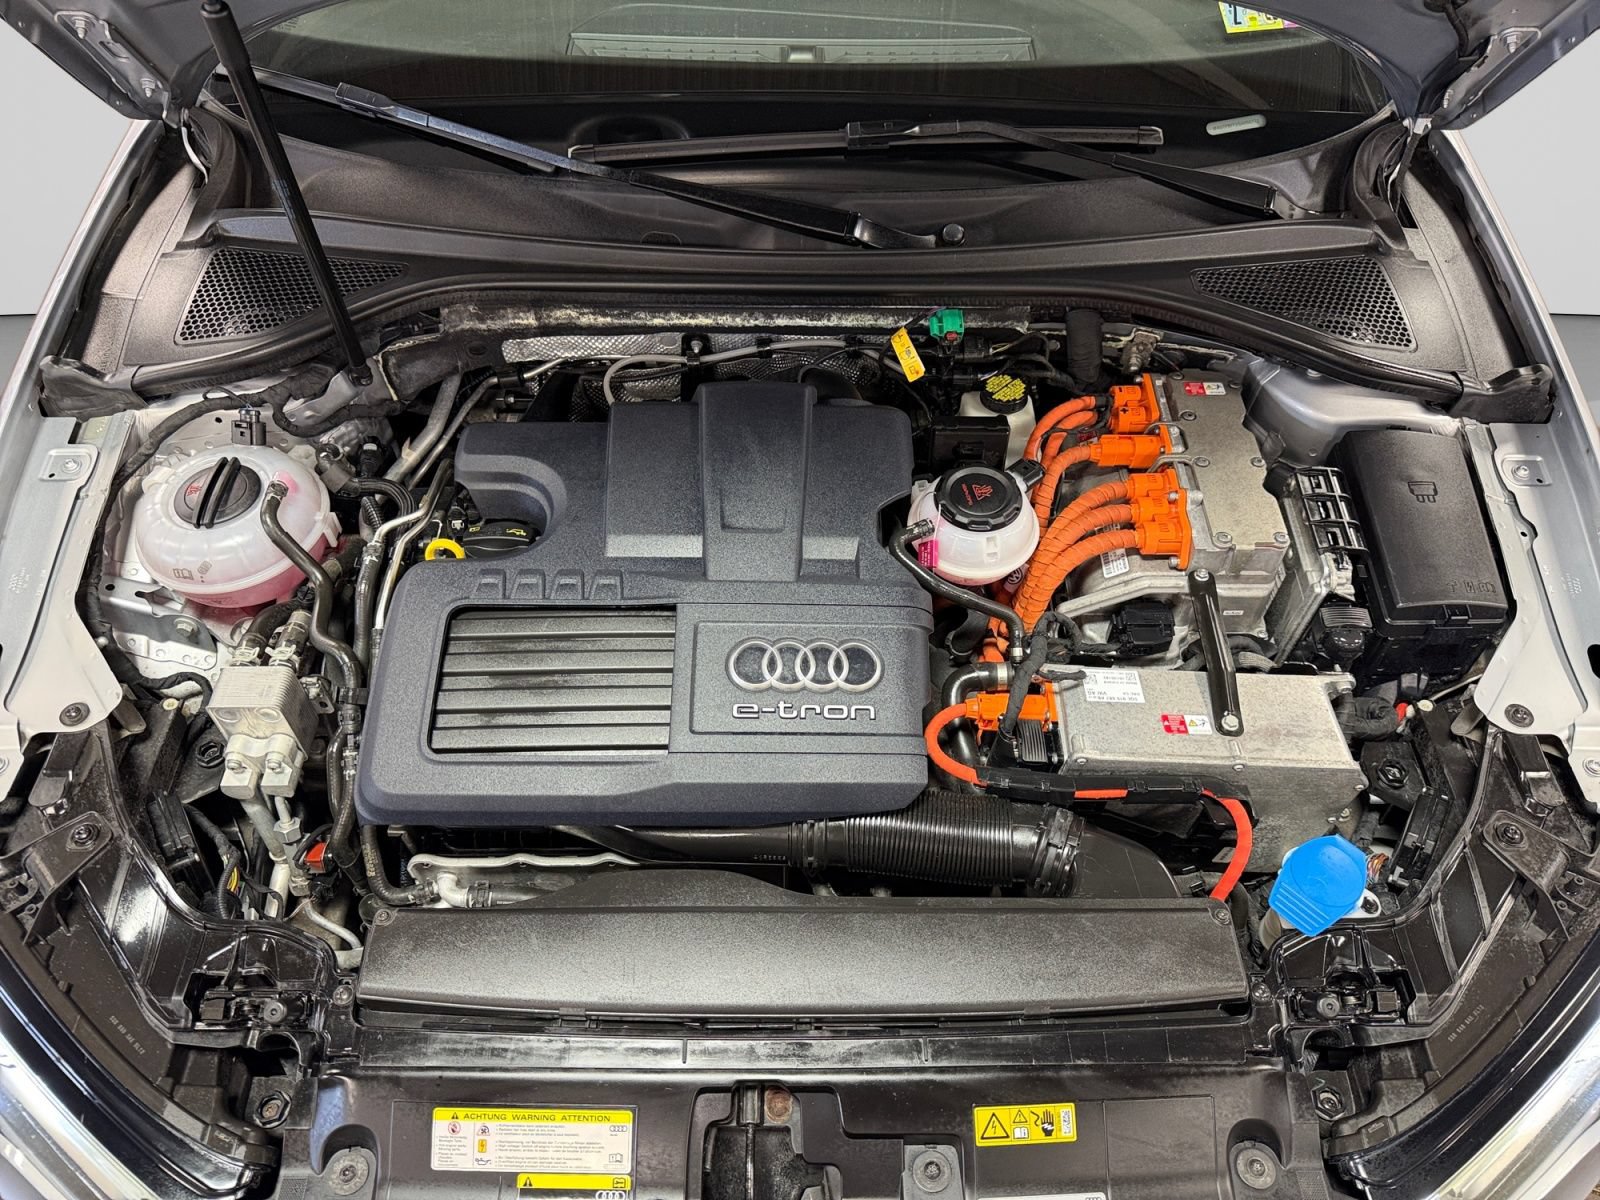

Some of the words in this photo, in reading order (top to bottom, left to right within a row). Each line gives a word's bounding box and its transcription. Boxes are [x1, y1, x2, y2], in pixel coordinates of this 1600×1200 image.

[732, 700, 877, 720] e-tron
[463, 1113, 507, 1121] ACHTUNG
[512, 1113, 556, 1122] WARNING
[560, 1114, 611, 1123] ATTENTION
